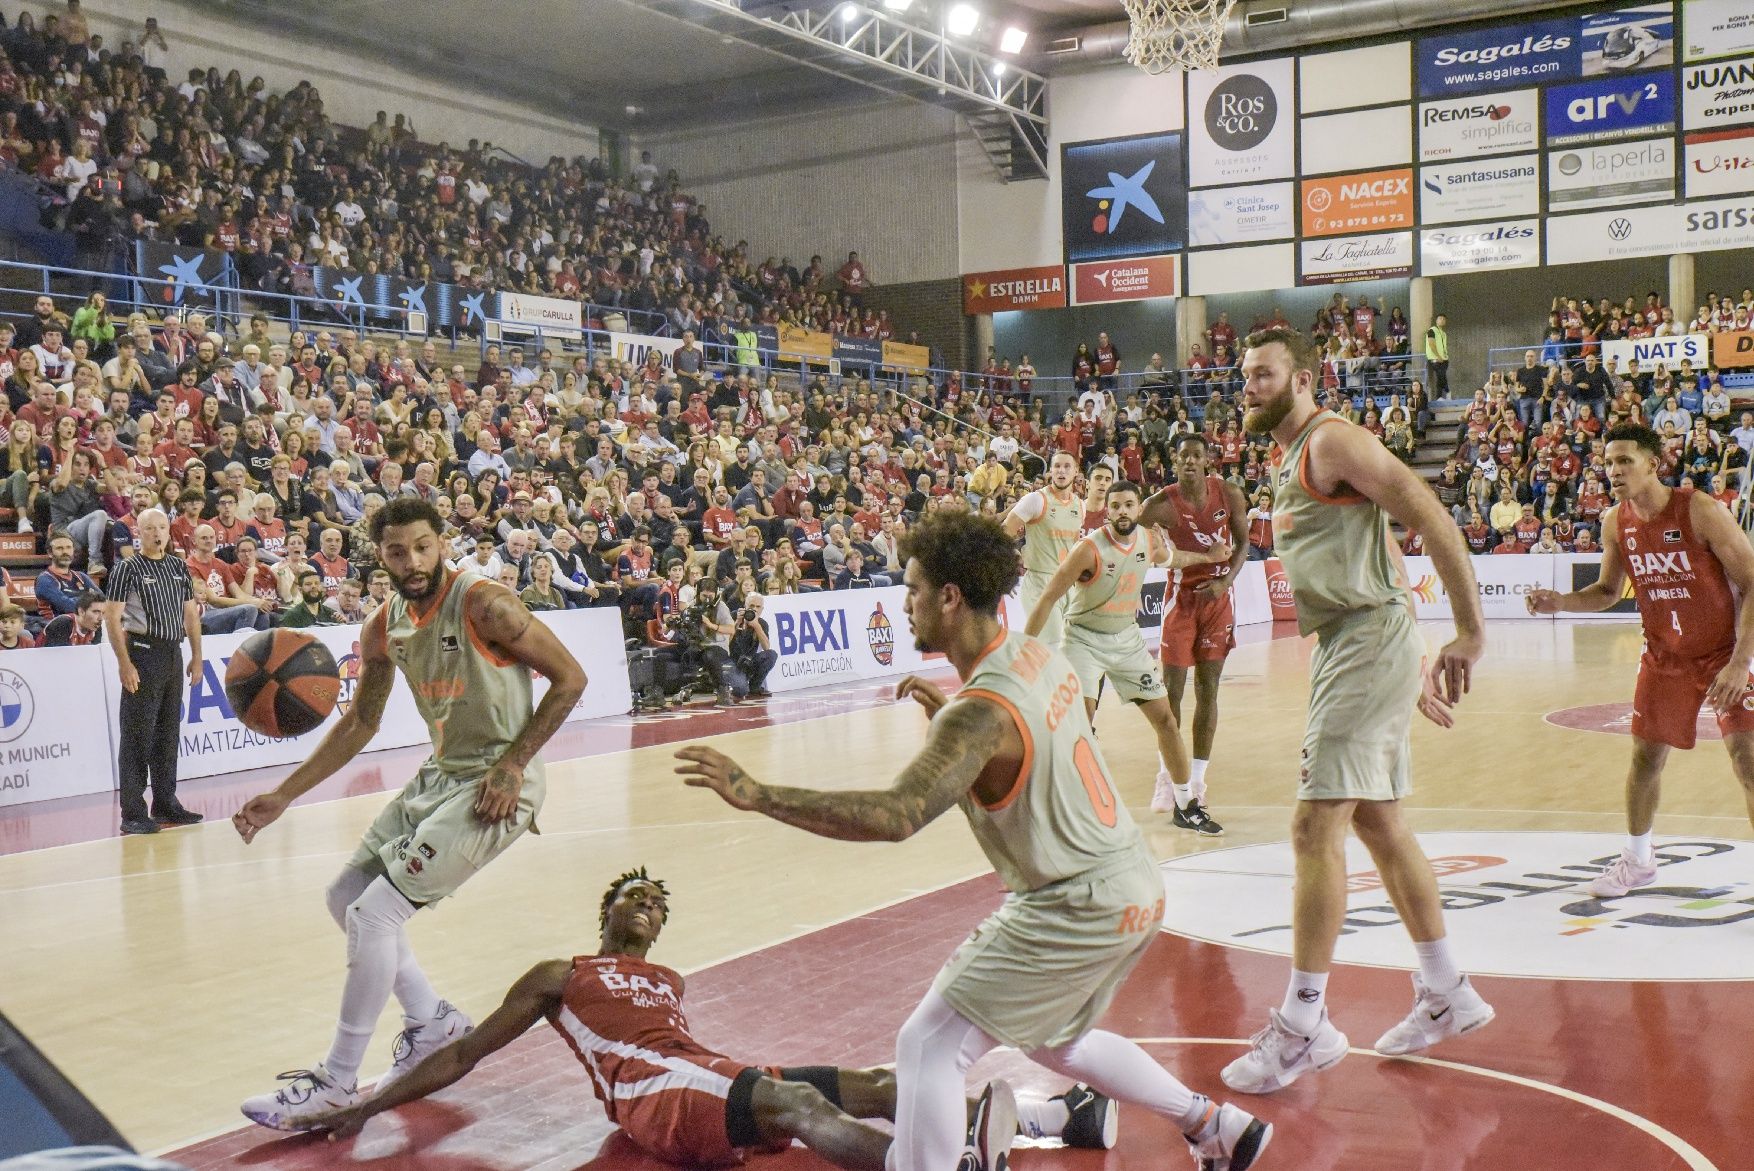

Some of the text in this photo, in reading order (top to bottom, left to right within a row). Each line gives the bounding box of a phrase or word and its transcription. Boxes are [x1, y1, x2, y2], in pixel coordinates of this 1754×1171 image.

[1434, 34, 1571, 66] Sagalés
[1444, 61, 1560, 85] www.sagales.com
[1461, 119, 1533, 140] simplifica
[1447, 166, 1536, 185] santasusana
[1339, 178, 1410, 202] NACEX
[1686, 208, 1754, 232] sars
[1111, 267, 1149, 278] Catalana
[1111, 275, 1149, 287] Occident
[990, 277, 1061, 298] ESTRELLA
[1012, 295, 1039, 305] DAMM
[2, 541, 33, 550] BAGES
[1518, 531, 1537, 540] BAXI
[1628, 550, 1693, 577] BAXI
[775, 609, 850, 656] BAXI
[1671, 610, 1683, 636] 4
[868, 626, 894, 644] BAXI
[781, 653, 854, 678] CLIMATIZACIÓN
[8, 742, 71, 763] MUNICH
[0, 769, 30, 791] ADÍ
[1072, 735, 1117, 829] 0
